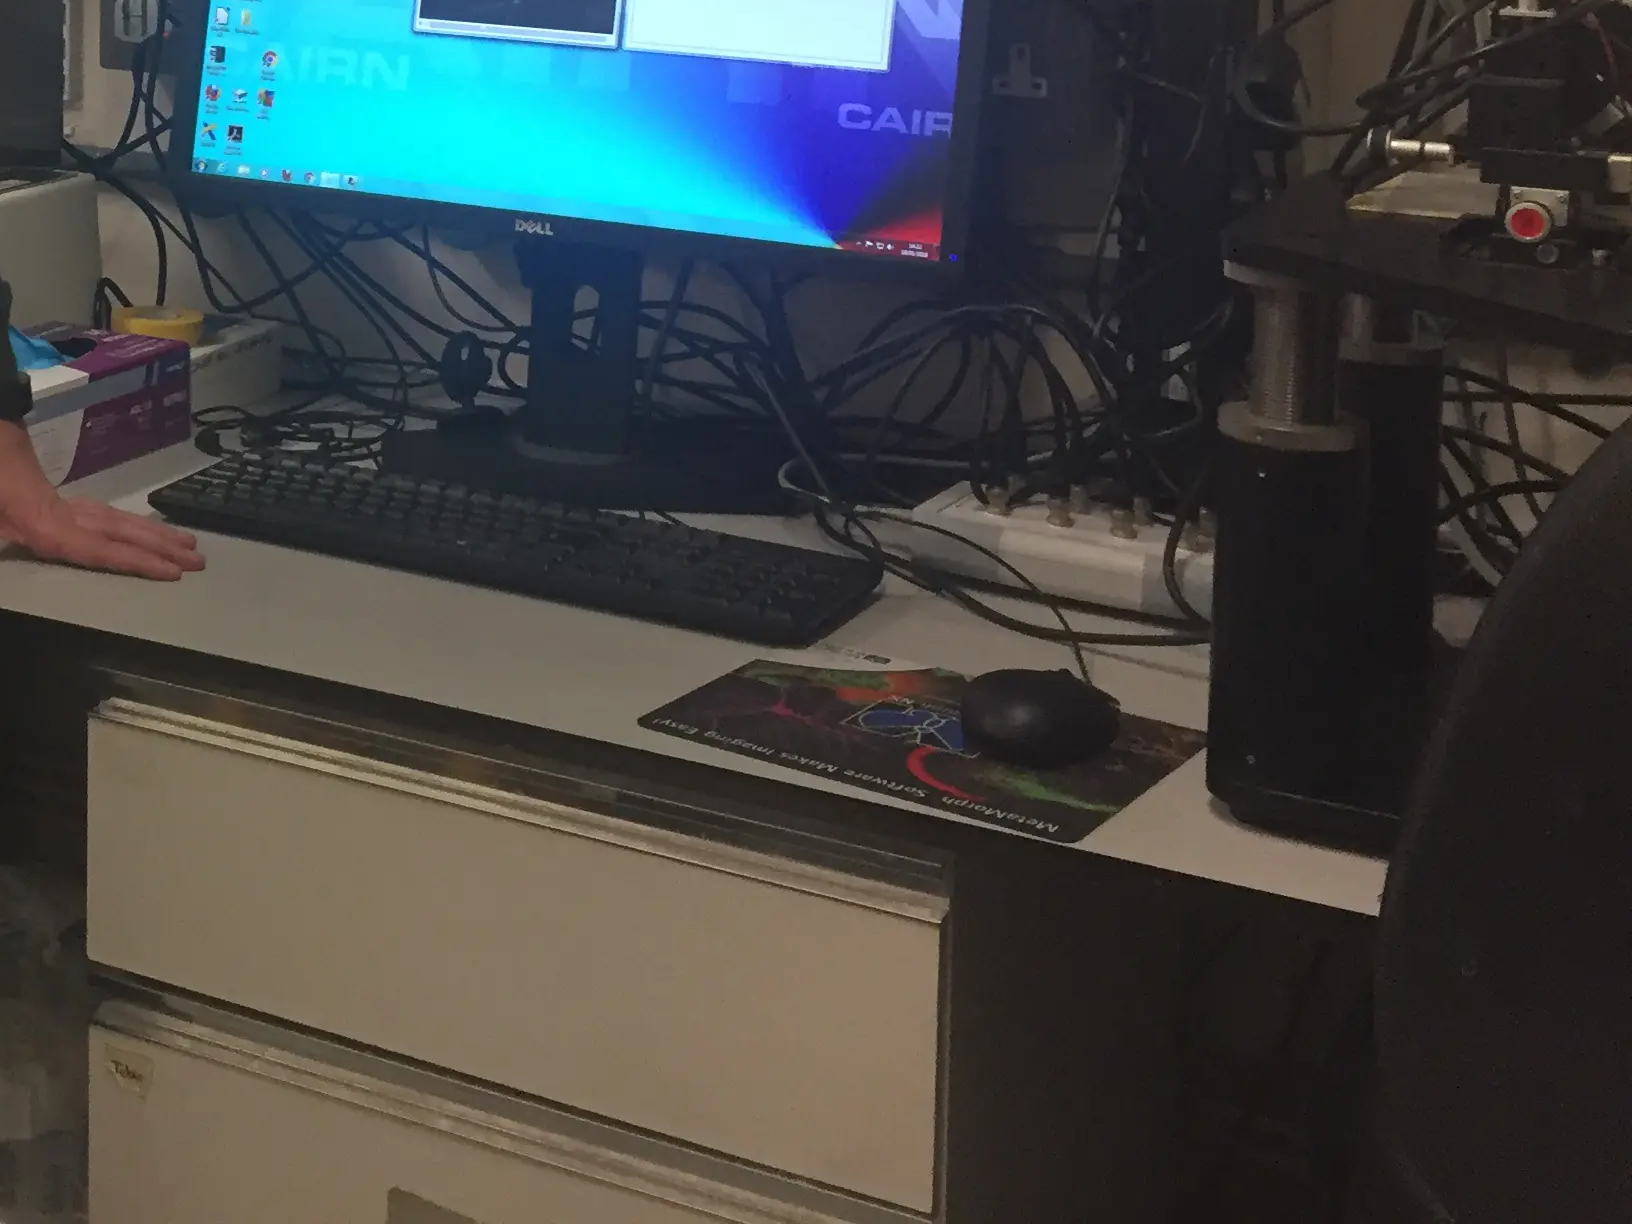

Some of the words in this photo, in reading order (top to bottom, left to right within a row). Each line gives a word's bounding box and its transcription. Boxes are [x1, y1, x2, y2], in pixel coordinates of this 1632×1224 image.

[515, 219, 554, 236] DELL
[652, 718, 699, 735] Easy!
[704, 730, 774, 756] Imaging
[781, 751, 838, 772] Makes
[844, 768, 930, 797] Software
[941, 795, 1059, 833] MetaMorph
